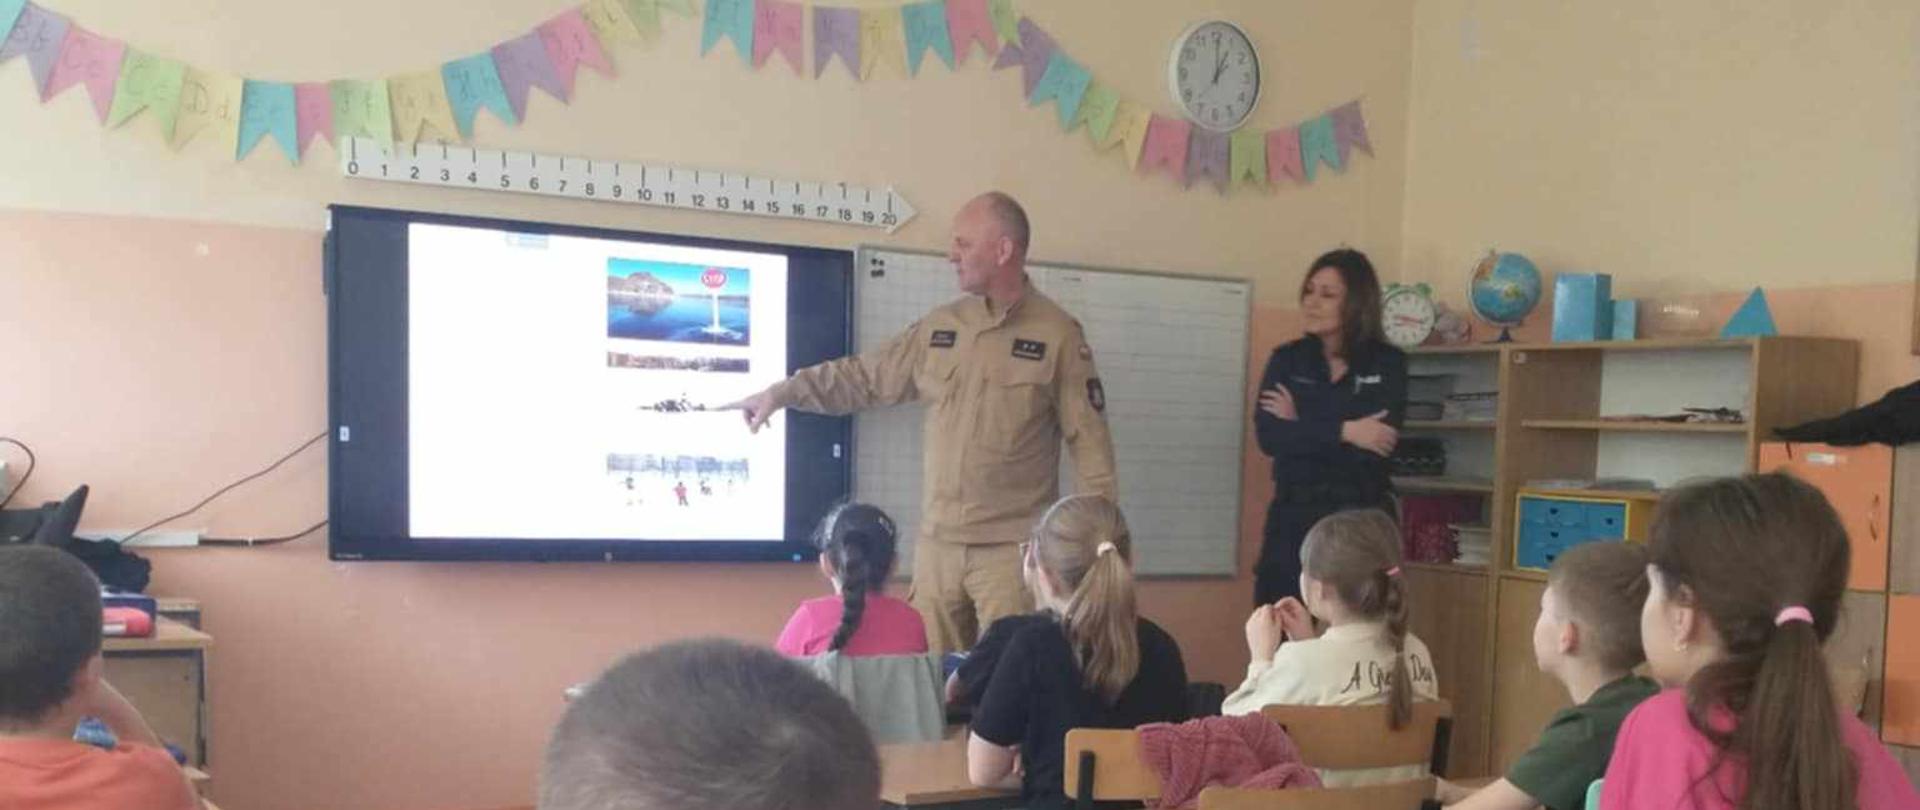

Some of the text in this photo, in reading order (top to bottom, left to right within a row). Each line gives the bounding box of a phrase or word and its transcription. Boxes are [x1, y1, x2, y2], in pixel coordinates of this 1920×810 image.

[1237, 52, 1246, 65] 2
[1180, 67, 1189, 81] 9
[1183, 88, 1193, 103] 8
[1238, 92, 1246, 103] 4
[1211, 107, 1219, 121] 6
[348, 162, 897, 225] 0 1 2 3 4 5 6 7 8 9 10 11 12 13 14 15 16 17 18 19 20
[1340, 661, 1361, 694] A
